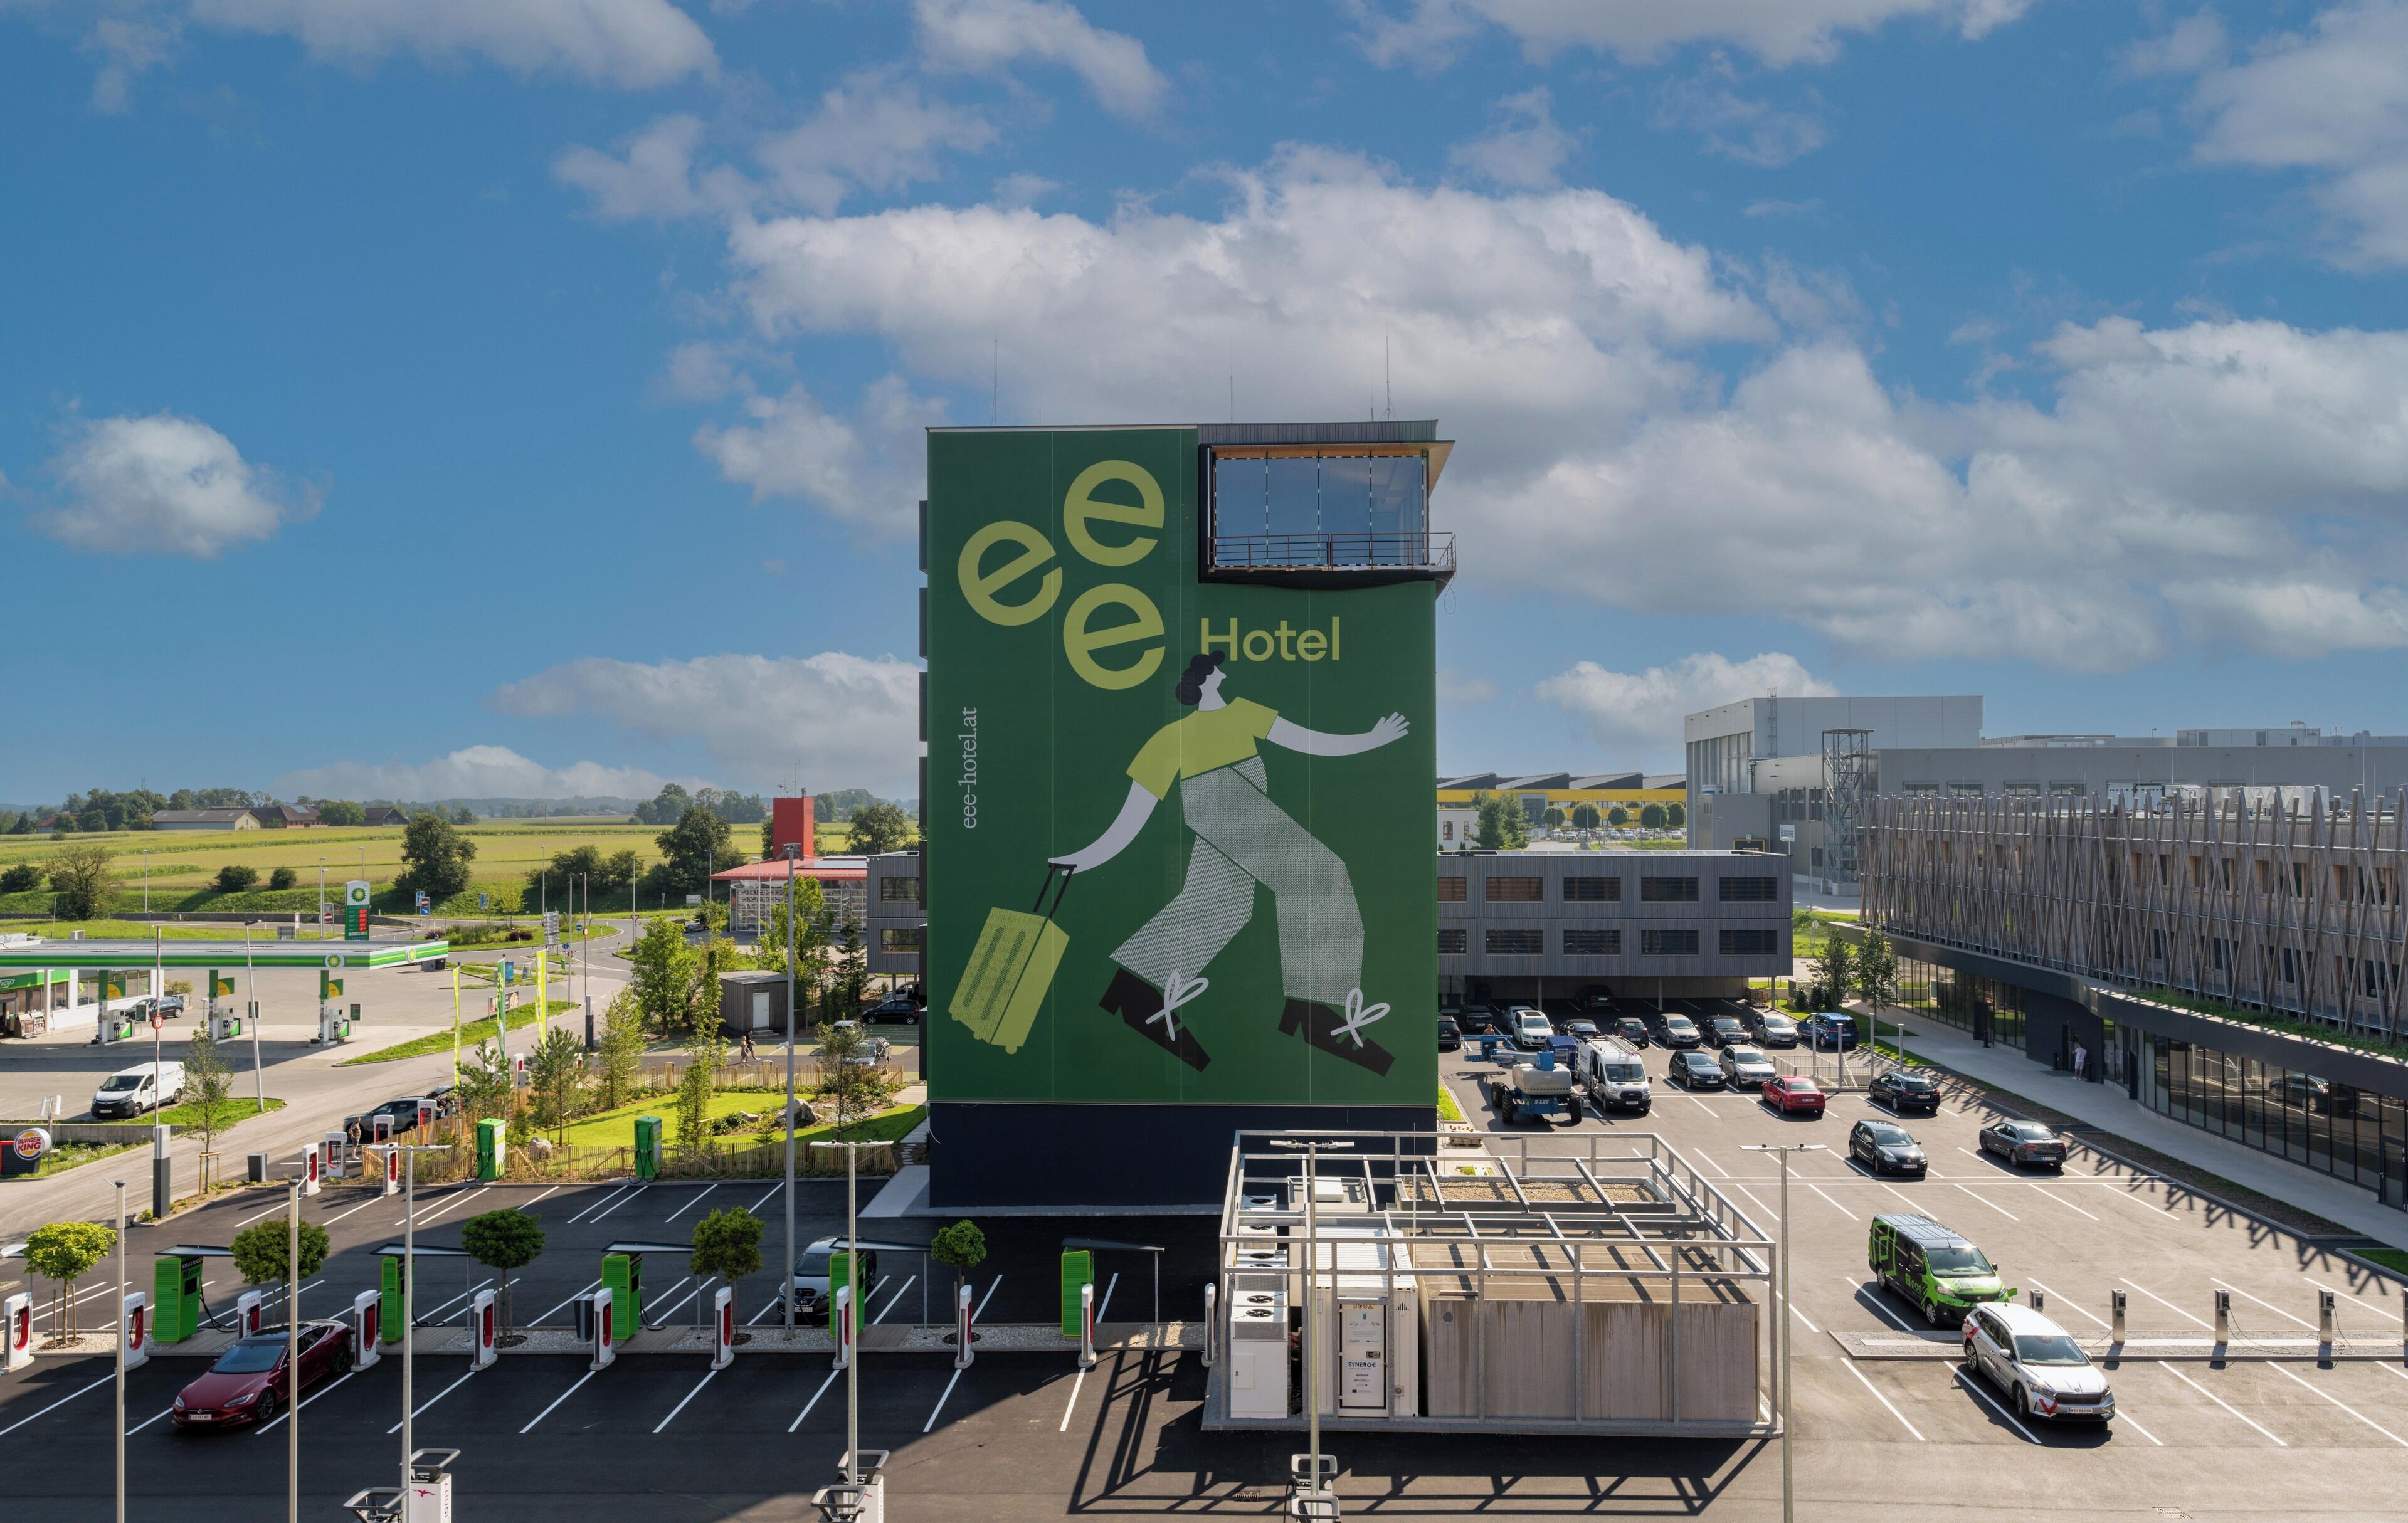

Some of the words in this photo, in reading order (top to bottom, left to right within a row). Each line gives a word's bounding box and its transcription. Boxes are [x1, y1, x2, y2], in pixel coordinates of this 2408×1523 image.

[1201, 616, 1339, 661] Hotel
[958, 707, 977, 829] eee-hotel.at
[18, 1142, 41, 1152] KING
[1911, 1280, 1922, 1293] pod
